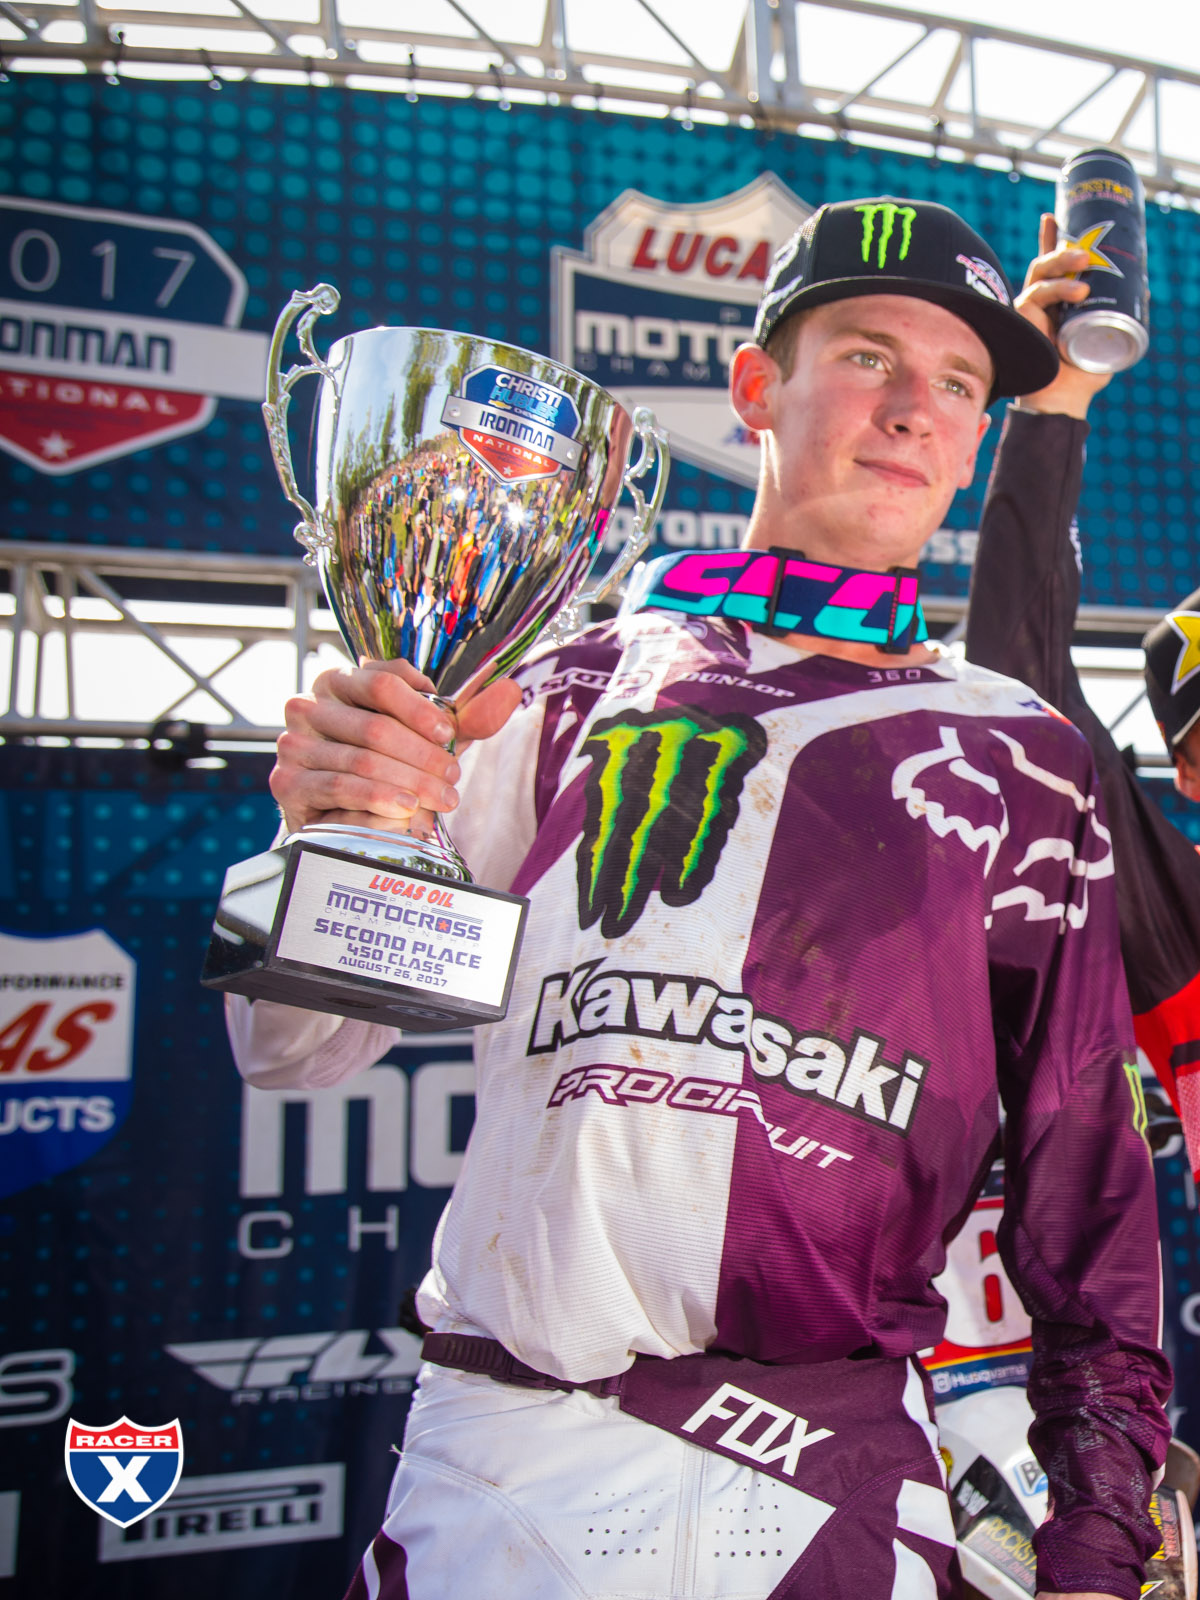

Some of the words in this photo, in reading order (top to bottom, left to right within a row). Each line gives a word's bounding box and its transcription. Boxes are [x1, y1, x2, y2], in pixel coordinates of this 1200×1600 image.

[9, 228, 196, 308] 017
[632, 227, 770, 282] LUCA
[0, 316, 175, 374] ONMAN
[7, 376, 179, 416] TIONAL
[489, 385, 560, 422] HUBLER
[495, 373, 563, 409] CHRISTI
[472, 433, 550, 468] NATIONAL
[479, 410, 555, 452] IRONMAN
[678, 671, 796, 698] DUNLOP
[867, 669, 921, 683] 360
[368, 874, 427, 901] LUCAS
[426, 889, 455, 908] OIL
[326, 890, 483, 942] MOTOCROSS
[313, 917, 407, 952] SECOND
[411, 940, 483, 970] PLACE
[347, 942, 384, 962] 450
[387, 952, 445, 976] CLASS
[338, 955, 392, 975] AUGUST
[393, 968, 413, 982] 26,
[416, 973, 448, 988] 2017
[528, 958, 930, 1138] Kawasaki
[0, 1096, 116, 1135] UCTS
[547, 1064, 674, 1109] PRO
[666, 1076, 855, 1169] CIRUIT
[231, 1378, 413, 1406] RACING
[681, 1382, 835, 1477] FOX
